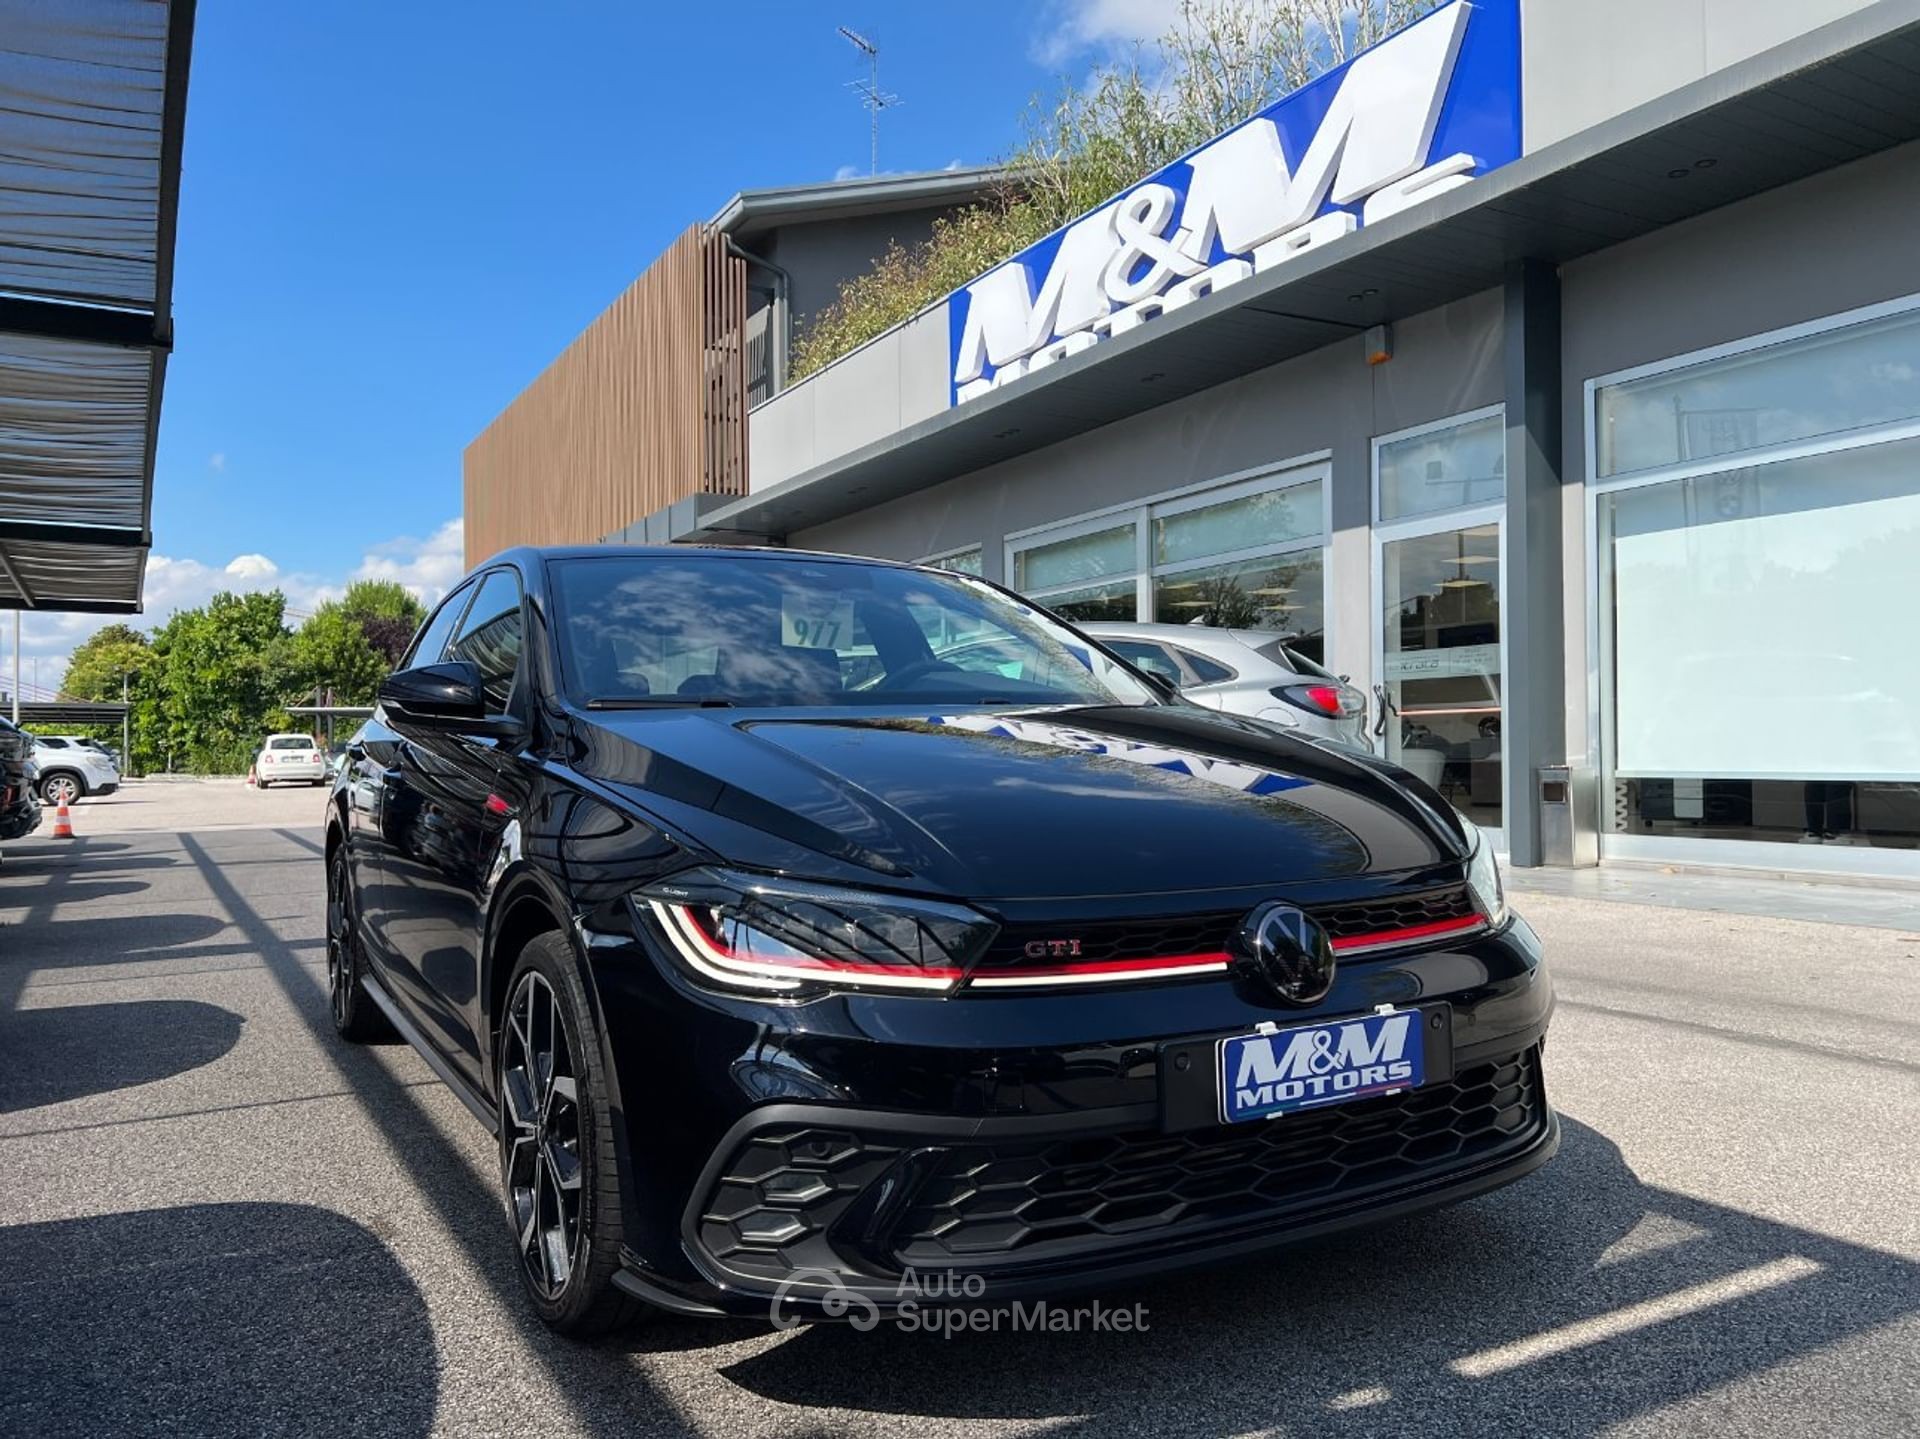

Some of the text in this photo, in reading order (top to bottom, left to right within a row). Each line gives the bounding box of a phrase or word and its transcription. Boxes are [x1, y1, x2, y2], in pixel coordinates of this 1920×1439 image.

[955, 1, 1473, 386] M&M
[794, 618, 842, 647] 977
[1024, 939, 1081, 957] GTI
[1236, 1015, 1410, 1088] M&M
[1237, 1061, 1412, 1109] MOTORS
